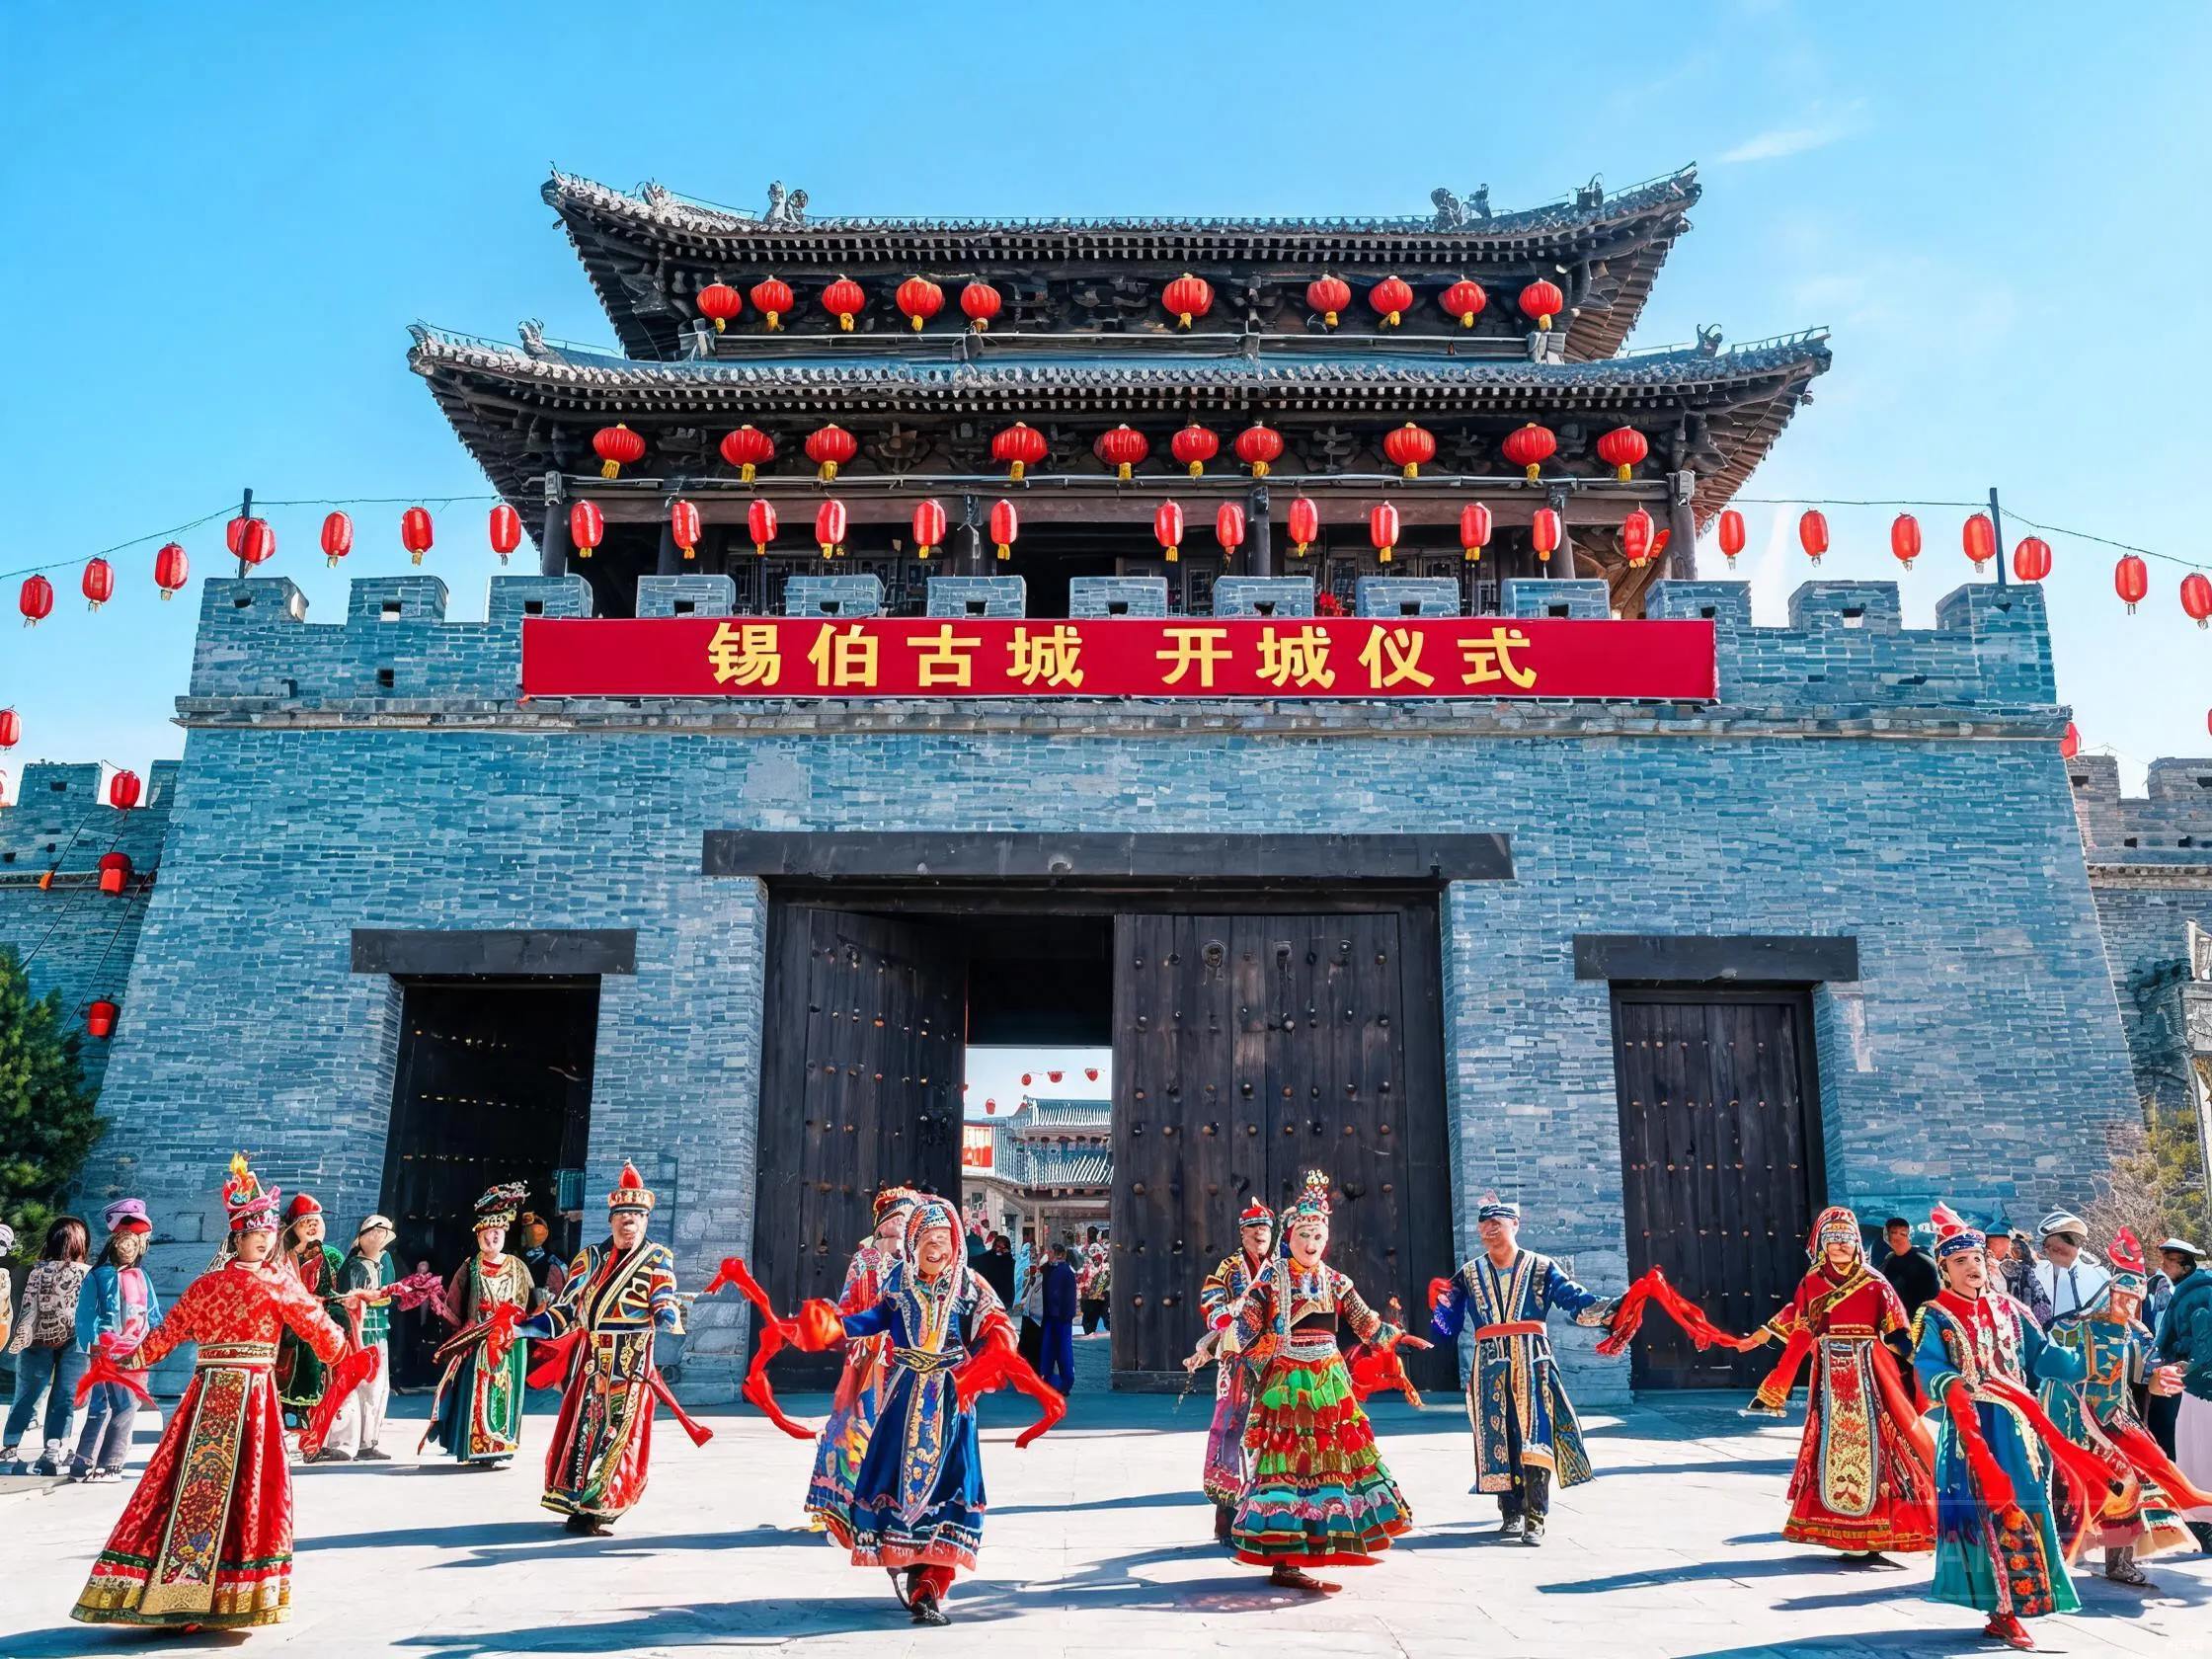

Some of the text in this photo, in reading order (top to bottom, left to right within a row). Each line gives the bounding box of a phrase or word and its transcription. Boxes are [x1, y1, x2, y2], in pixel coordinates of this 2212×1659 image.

[707, 624, 1538, 688] 锡伯古城 开城仪式
